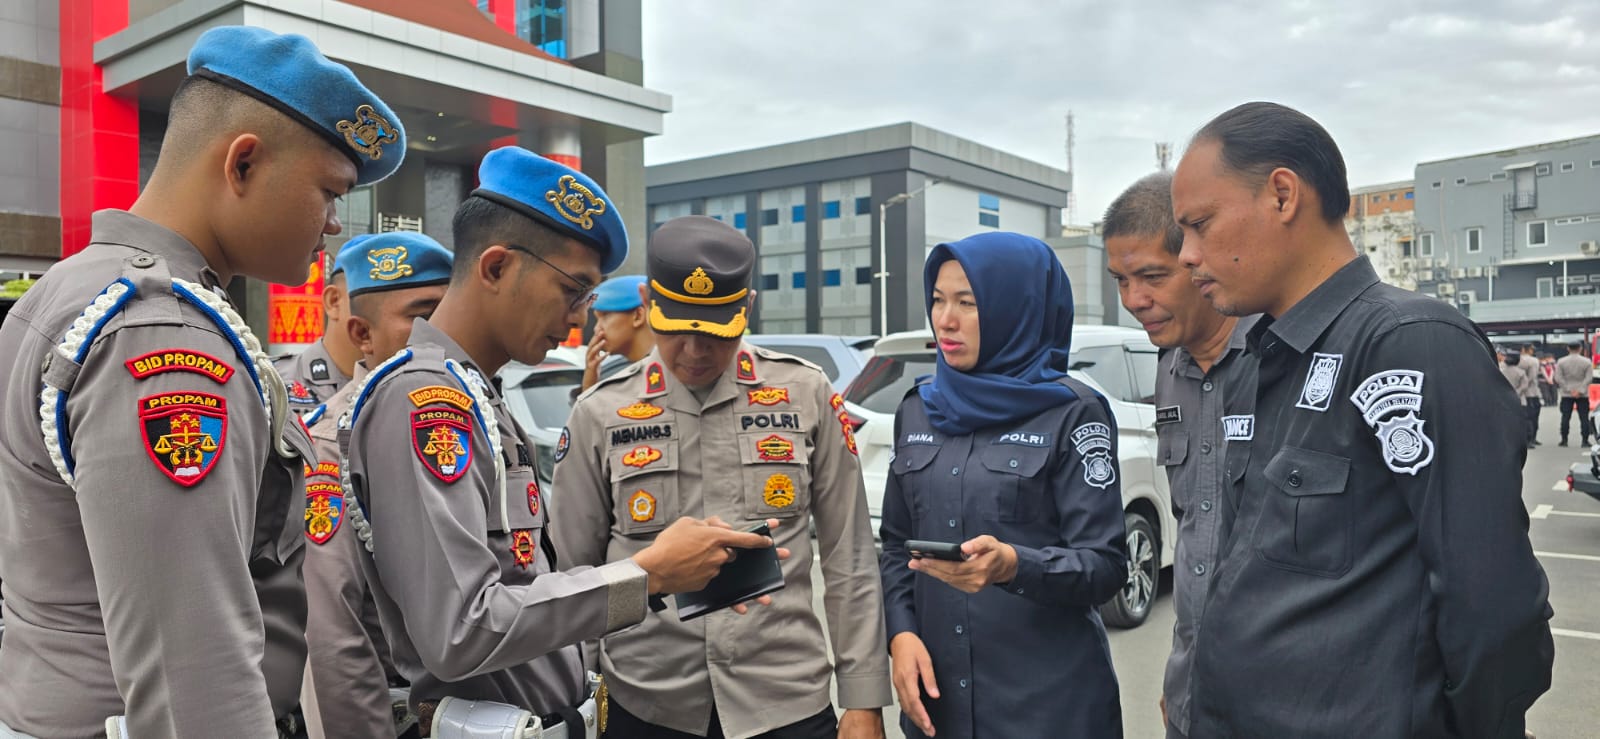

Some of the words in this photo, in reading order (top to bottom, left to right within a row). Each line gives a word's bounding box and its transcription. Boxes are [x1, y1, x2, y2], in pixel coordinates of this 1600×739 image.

[134, 355, 162, 373] BID
[164, 353, 227, 377] PROPAM
[1360, 375, 1415, 403] POLDA
[149, 394, 217, 408] PROPAM
[414, 390, 431, 402] BID
[431, 389, 468, 406] PROPAM
[419, 411, 464, 423] PROPAM
[741, 413, 799, 430] POLRI
[907, 433, 934, 443] DIANA
[1000, 433, 1044, 445] POLRI
[1075, 425, 1107, 440] POLDA
